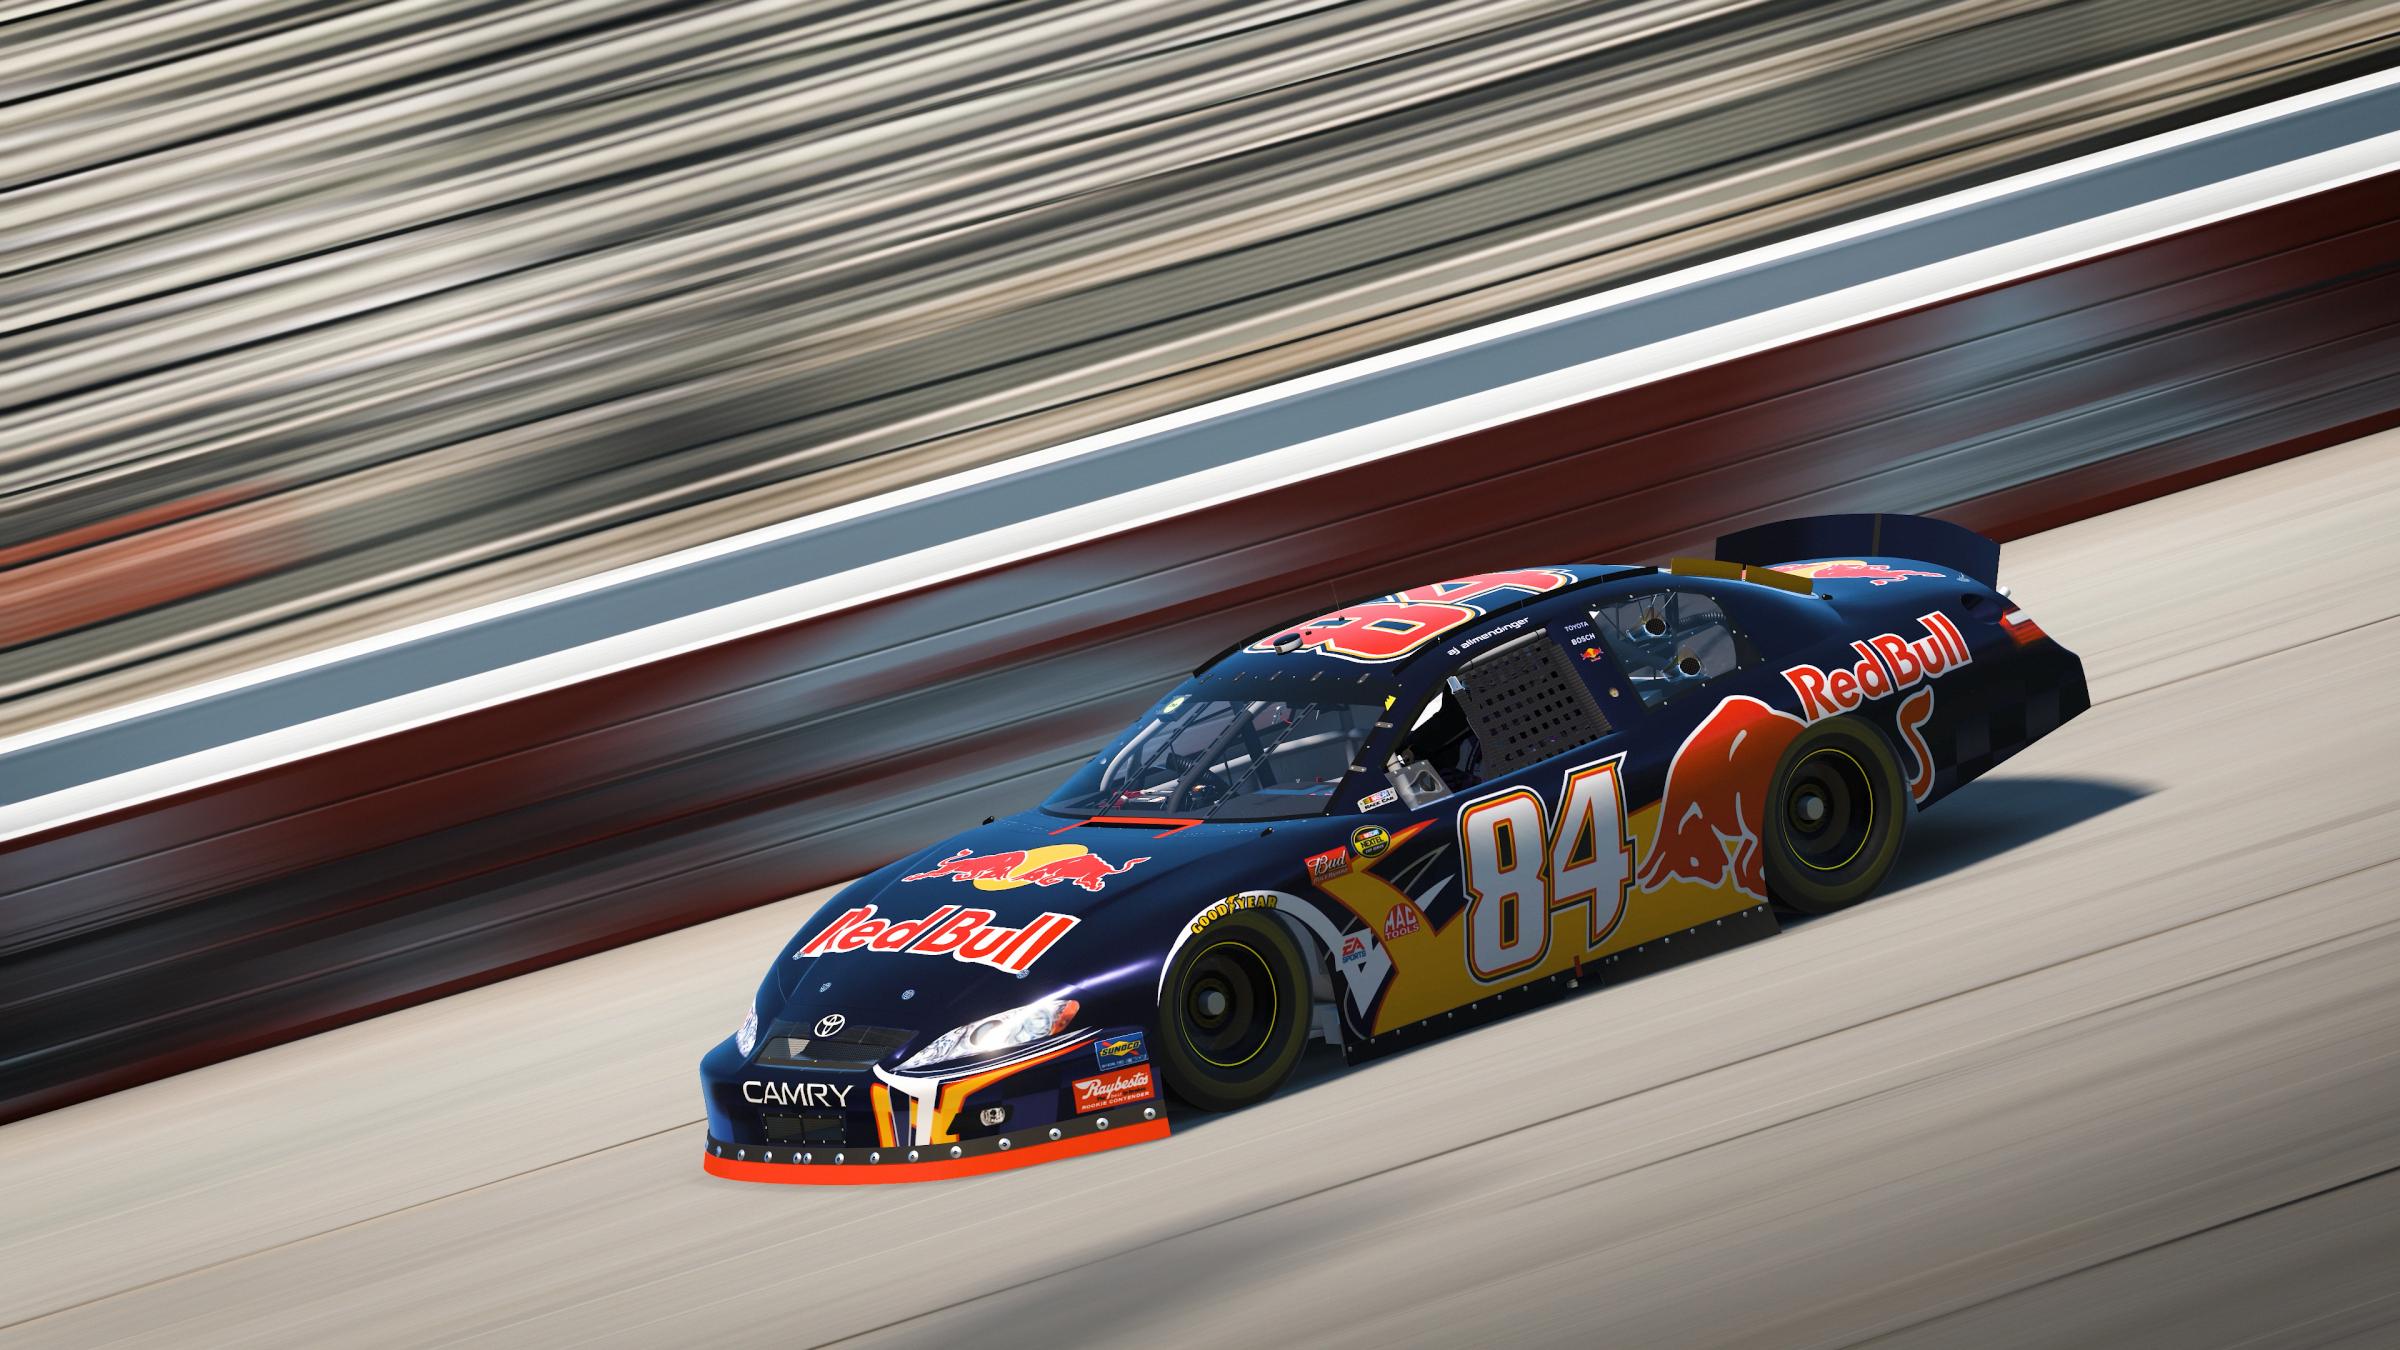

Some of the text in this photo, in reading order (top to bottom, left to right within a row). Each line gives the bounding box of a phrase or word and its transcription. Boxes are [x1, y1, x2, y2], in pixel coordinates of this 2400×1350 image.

[1447, 616, 1530, 657] aj allmendinger
[1564, 621, 1590, 632] TOYOTA
[1570, 632, 1596, 646] BOSCH
[1780, 610, 1973, 723] Red Bull
[1307, 849, 1346, 876] Bud
[1457, 750, 1638, 986] 84
[1190, 893, 1278, 935] GOODYEAR
[1385, 903, 1417, 933] MAC
[802, 904, 1082, 975] Red Bull
[1385, 922, 1420, 940] TOOLS
[1342, 937, 1366, 957] EA
[1342, 950, 1367, 963] SPORTS
[1101, 1040, 1142, 1057] SUNOCO
[742, 1080, 855, 1108] CAMRY
[1075, 1072, 1149, 1100] Raybestos
[1081, 1100, 1108, 1111] ROOKIE
[1109, 1091, 1151, 1105] CONTENDER
